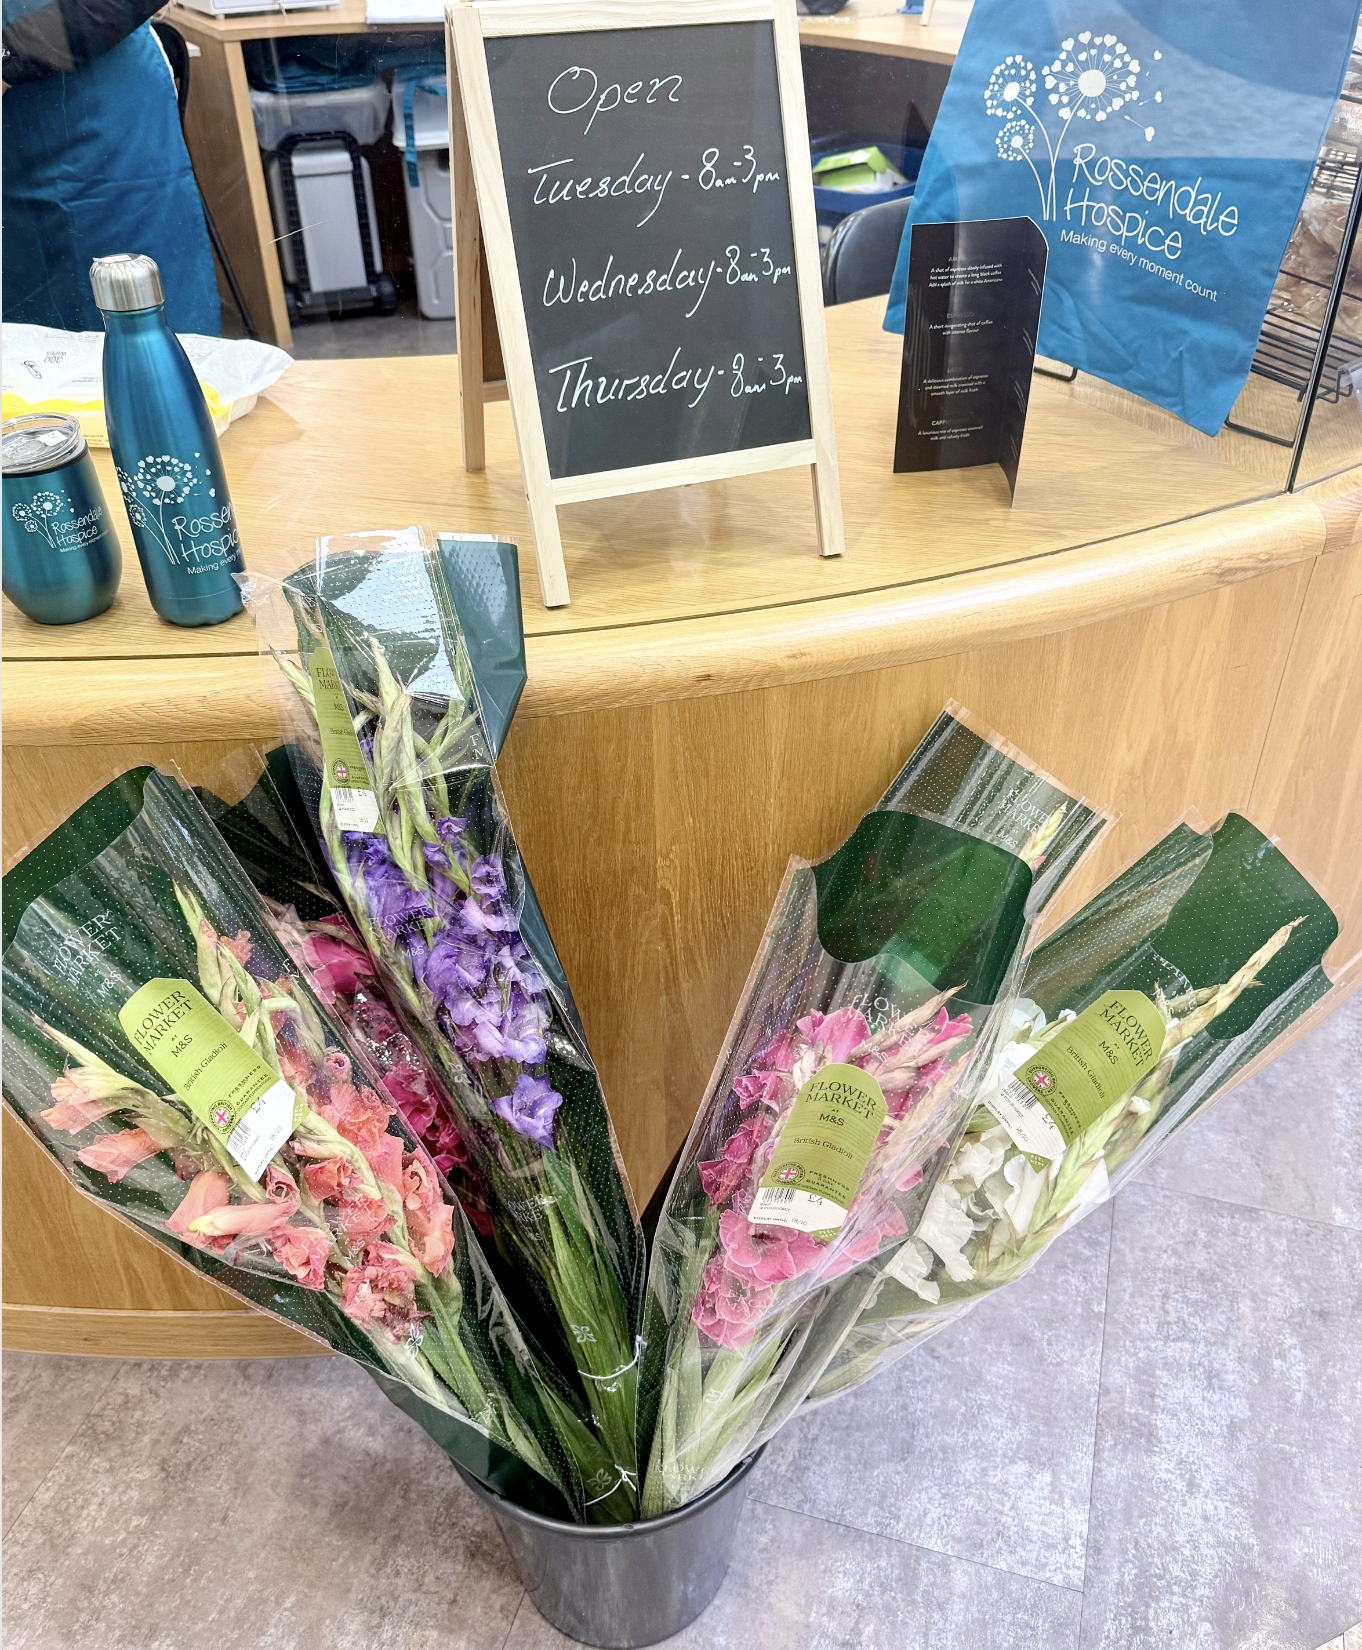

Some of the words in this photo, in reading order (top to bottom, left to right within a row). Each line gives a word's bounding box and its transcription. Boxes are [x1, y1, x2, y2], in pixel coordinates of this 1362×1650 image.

[548, 66, 682, 135] Open
[528, 153, 672, 227] Tuesday
[1072, 143, 1238, 236] Rossendale
[1064, 188, 1182, 259] Hospice
[543, 249, 715, 318] Wednesday
[1060, 229, 1107, 253] Making
[1109, 243, 1138, 266] every
[1138, 257, 1185, 287] moment
[1184, 279, 1218, 302] count
[549, 347, 715, 412] Thursday
[57, 526, 98, 547] Hospice
[187, 562, 219, 575] Making
[133, 990, 187, 1045] FLOWER
[143, 999, 193, 1056] MARKET
[1099, 1008, 1145, 1067] MARKET
[1109, 1000, 1153, 1060] FLOWER
[171, 1034, 193, 1058] M&S
[183, 1066, 203, 1092] British
[200, 1041, 228, 1069] Gladioli
[1099, 1040, 1119, 1065] M&S
[809, 1081, 877, 1111] FLOWER
[1066, 1046, 1088, 1076] British
[1087, 1068, 1105, 1099] Gladioli
[251, 1097, 266, 1113] £4
[805, 1093, 874, 1120] MARKET
[818, 1113, 845, 1127] M&S
[1041, 1113, 1057, 1130] £4
[793, 1137, 821, 1146] British
[822, 1141, 853, 1160] Gladioli
[807, 1194, 823, 1206] £4
